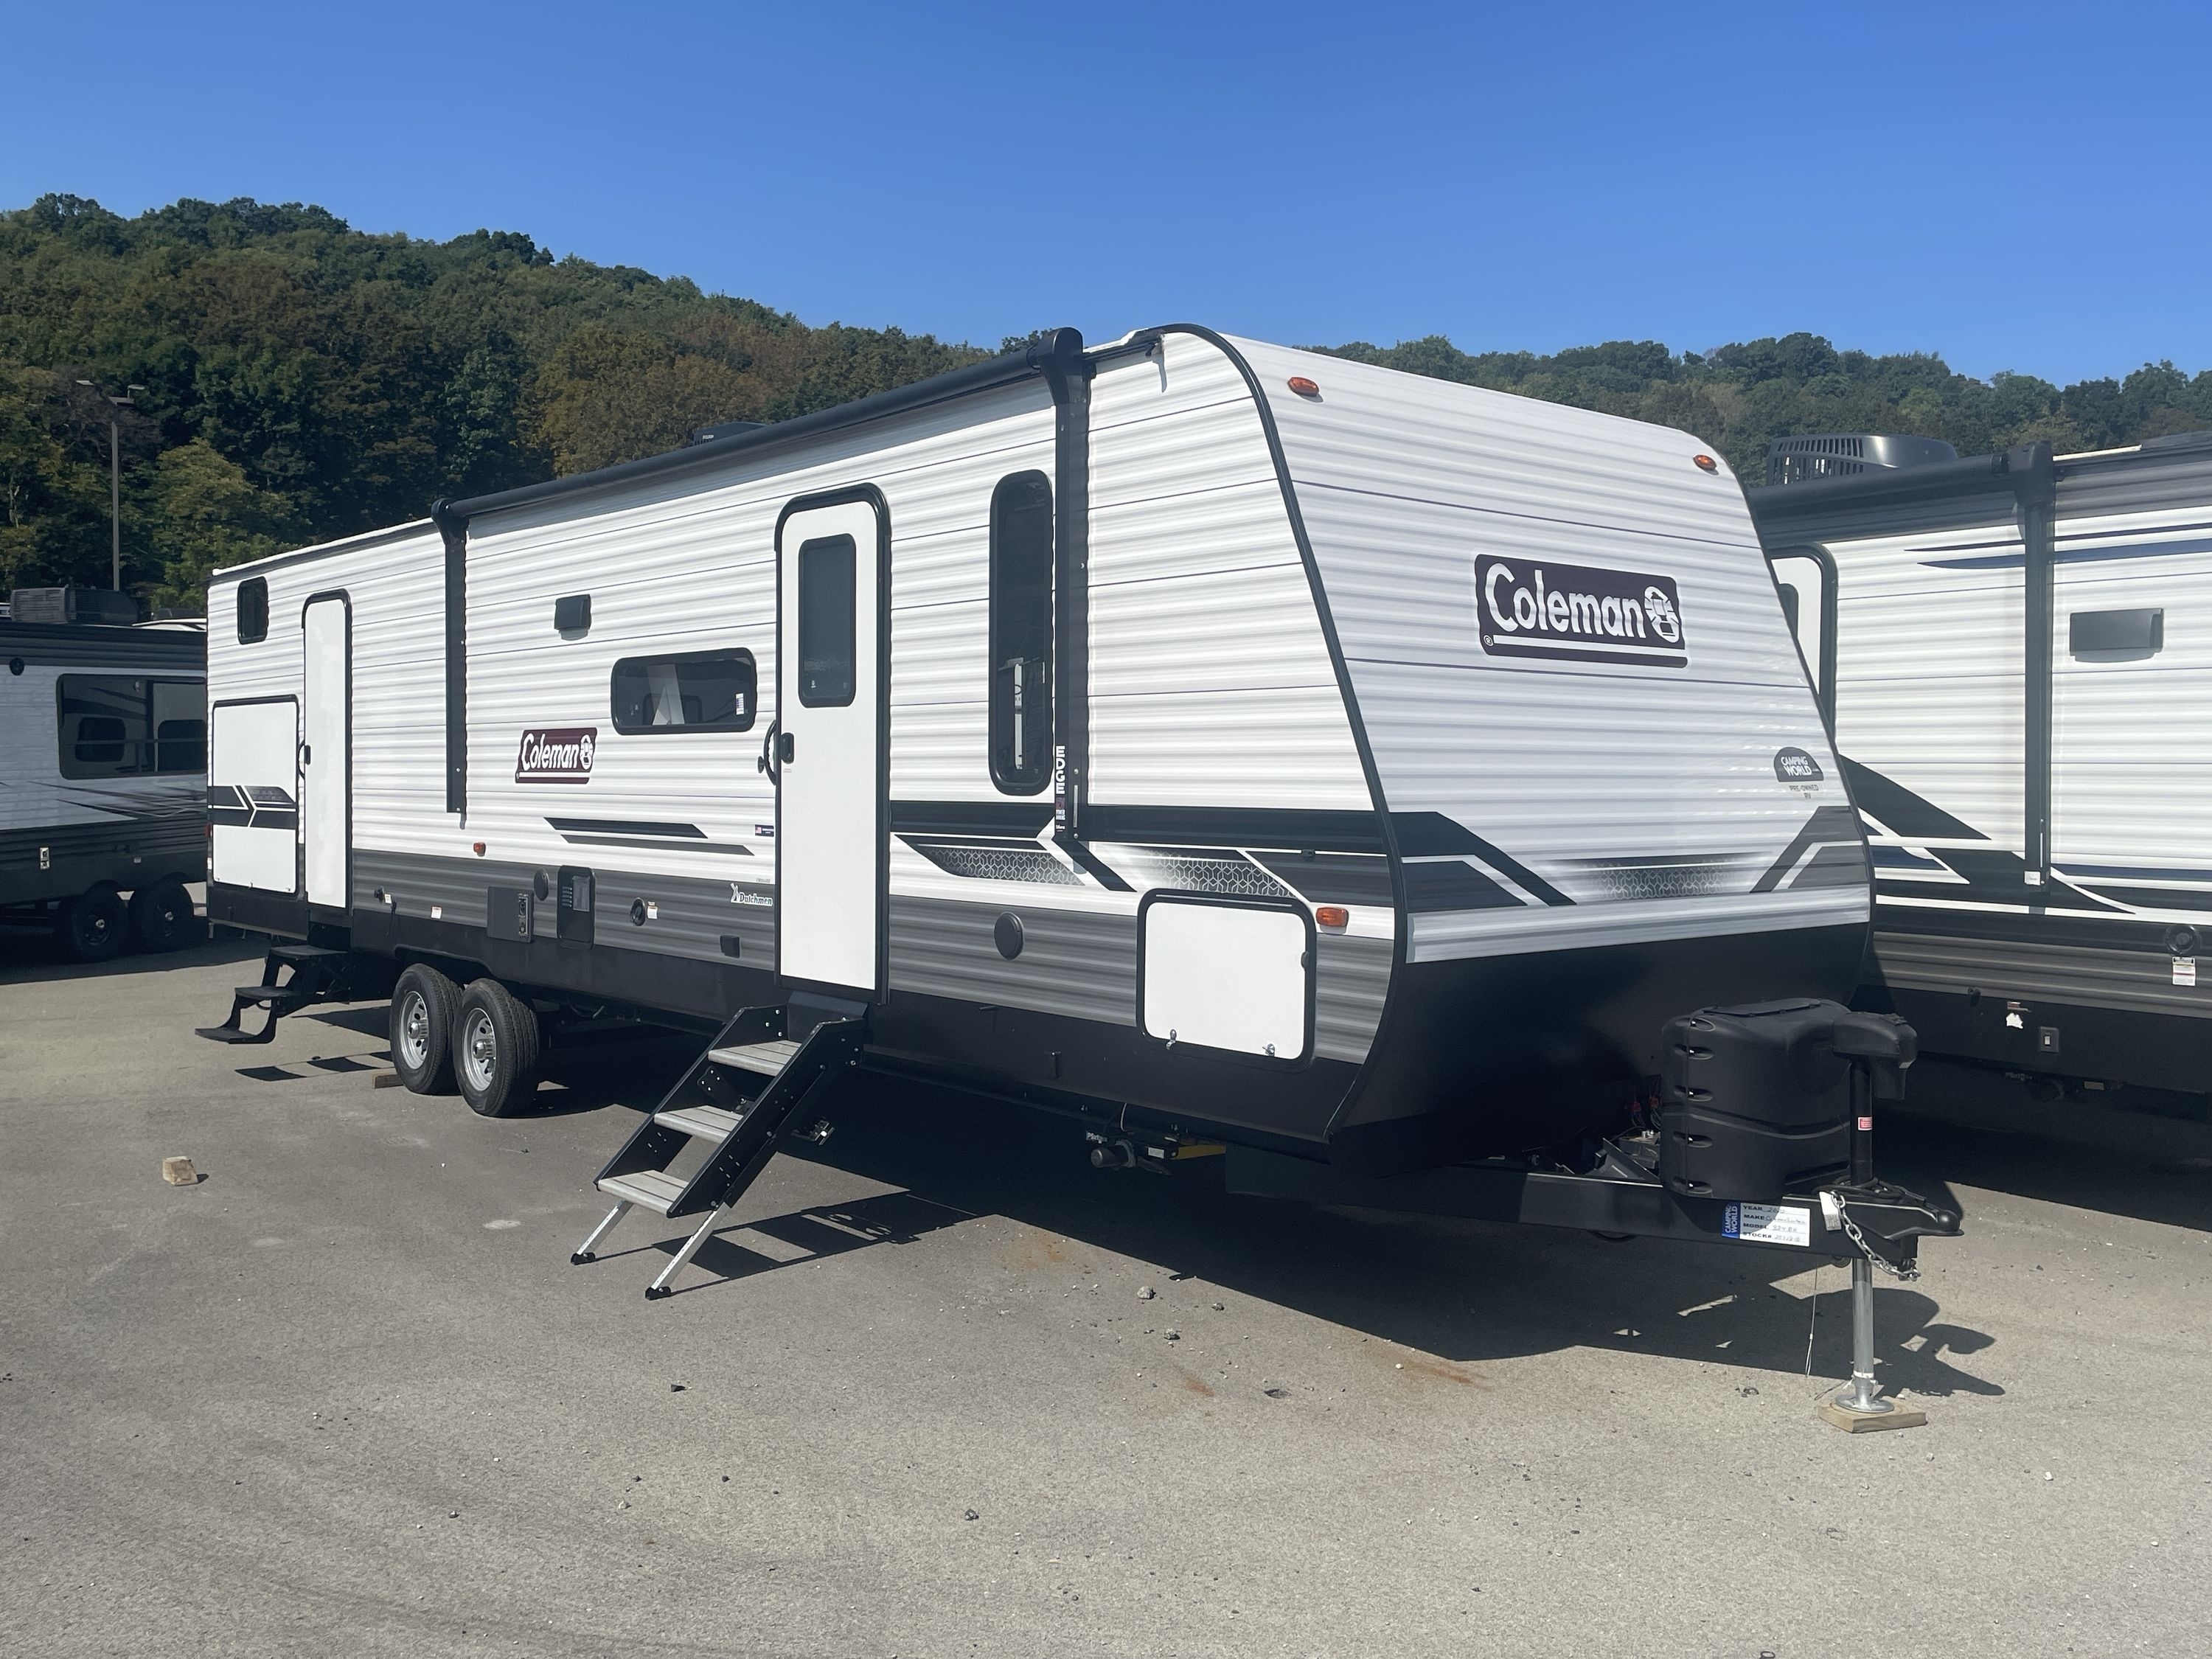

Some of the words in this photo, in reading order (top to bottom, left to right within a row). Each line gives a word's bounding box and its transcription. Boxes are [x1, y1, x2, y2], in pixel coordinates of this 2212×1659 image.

[1484, 563, 1646, 639] Coleman
[521, 733, 580, 771] Coleman
[1781, 756, 1809, 765] CAMPING
[1055, 745, 1065, 794] EDGE
[1783, 765, 1812, 776] WORLD
[739, 892, 773, 905] Dutchmen
